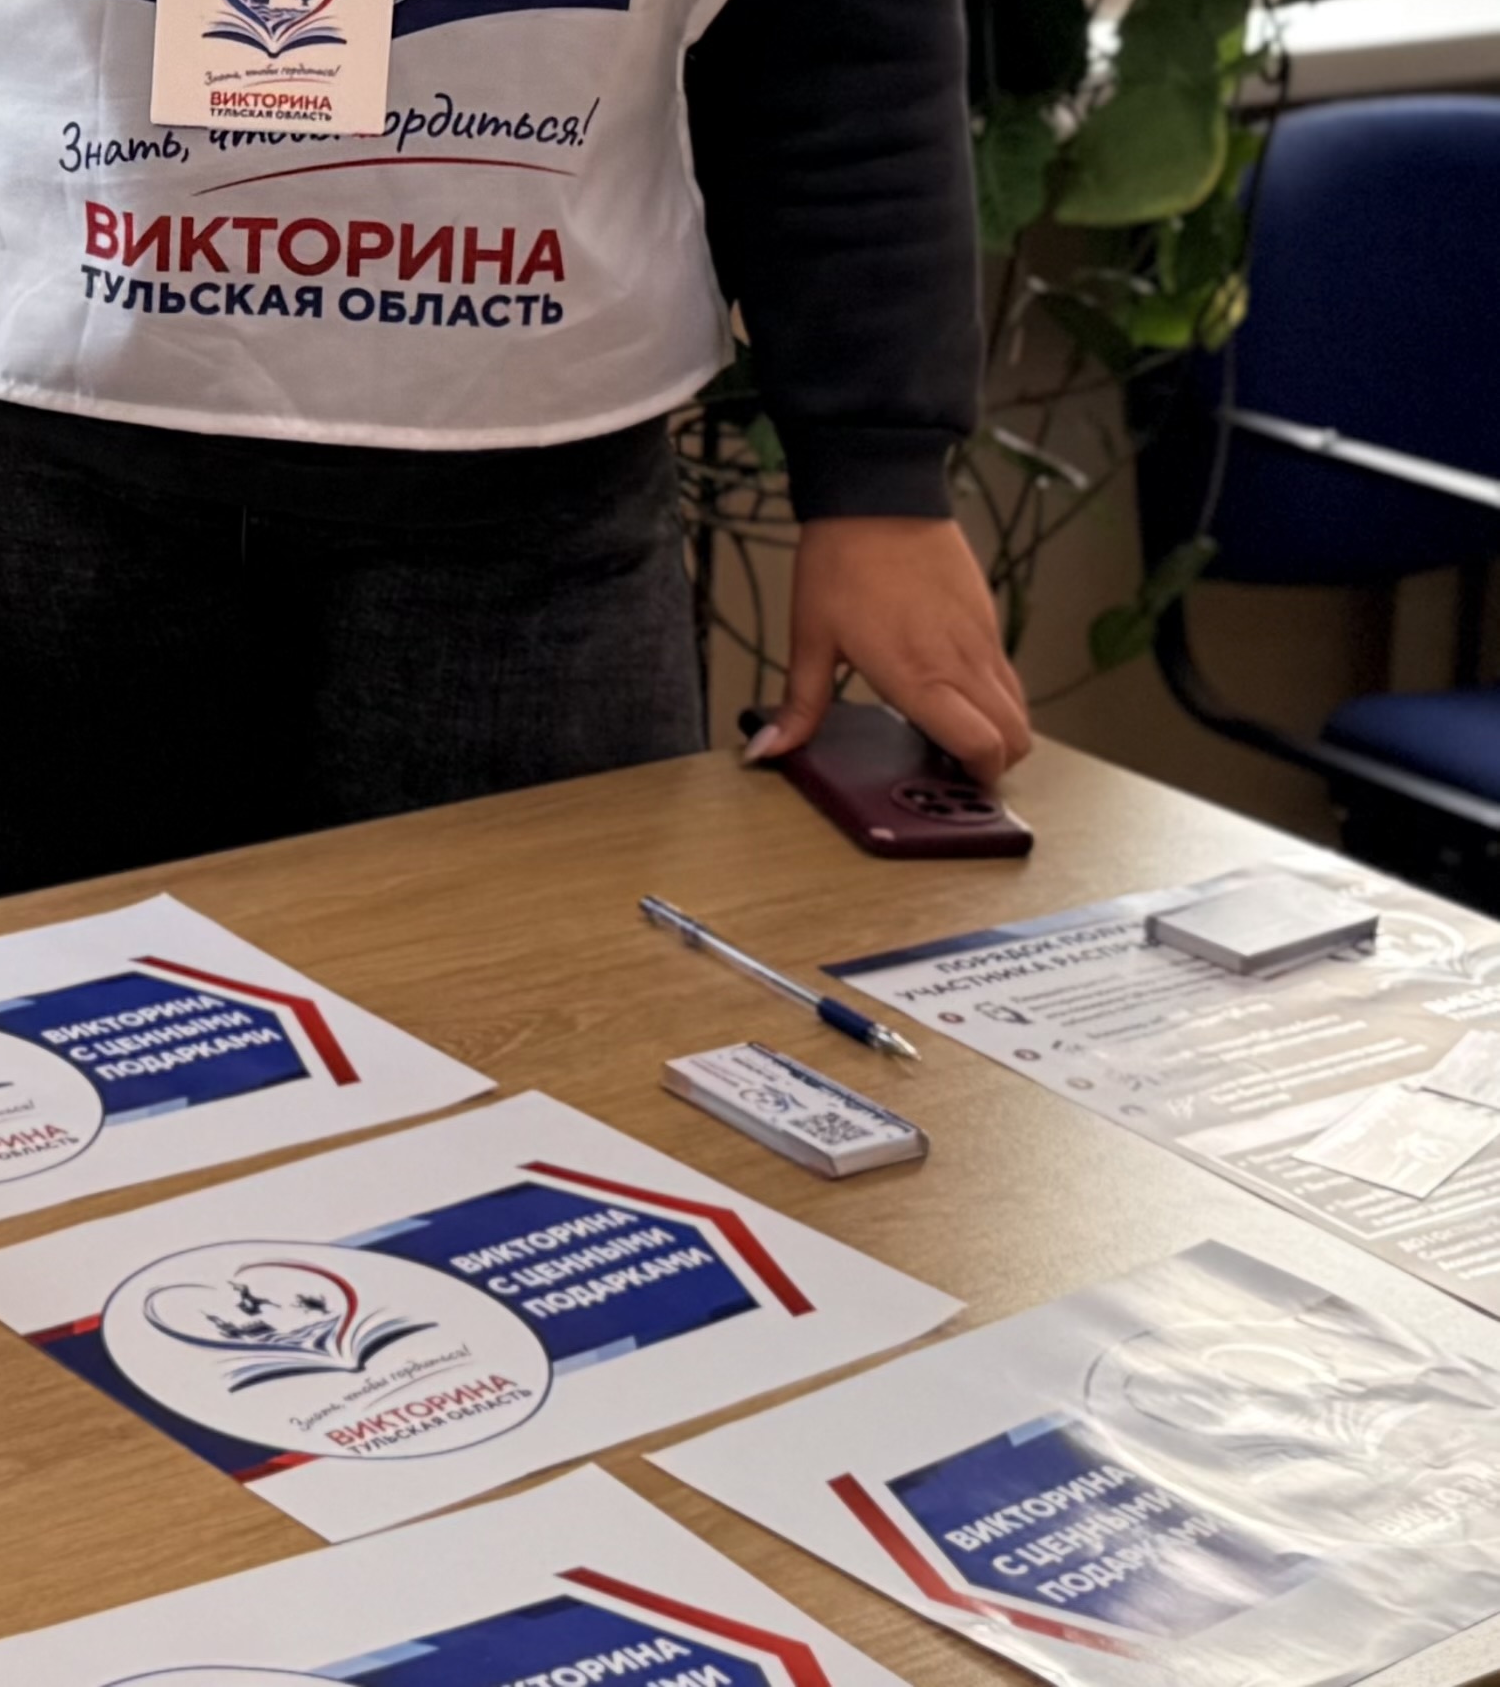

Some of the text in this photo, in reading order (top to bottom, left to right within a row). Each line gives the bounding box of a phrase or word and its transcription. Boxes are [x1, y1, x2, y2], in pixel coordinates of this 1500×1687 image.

[59, 121, 190, 173] Знать,
[384, 92, 600, 154] ордиться!
[209, 91, 332, 111] ВИКТОРИНА
[209, 107, 332, 122] ТУЛЬСКАЯ ОБЛАСТЬ
[85, 200, 565, 285] ВИКТОРИНА
[80, 264, 564, 329] ТУЛЬСКАЯ ОБЛАСТЬ
[40, 994, 226, 1045] ВИКТОРИНА
[69, 1009, 254, 1063] С ЦЕННЫМИ
[94, 1026, 283, 1082] ПОДАРКАМИ
[449, 1206, 640, 1275] ВИКТОРИНА
[487, 1225, 677, 1296] С ЦЕННЫМИ
[521, 1245, 715, 1319] ПОДАРКАМИ
[325, 1373, 519, 1447] ВИКТОРИНА
[347, 1387, 533, 1456] ТУЛЬСКАЯ ОБЛАСТЬ
[943, 1464, 1139, 1553] ВИКТОРИНА
[992, 1485, 1183, 1578] С ЦЕННЫМИ
[501, 1636, 693, 1687] ТОРИНА
